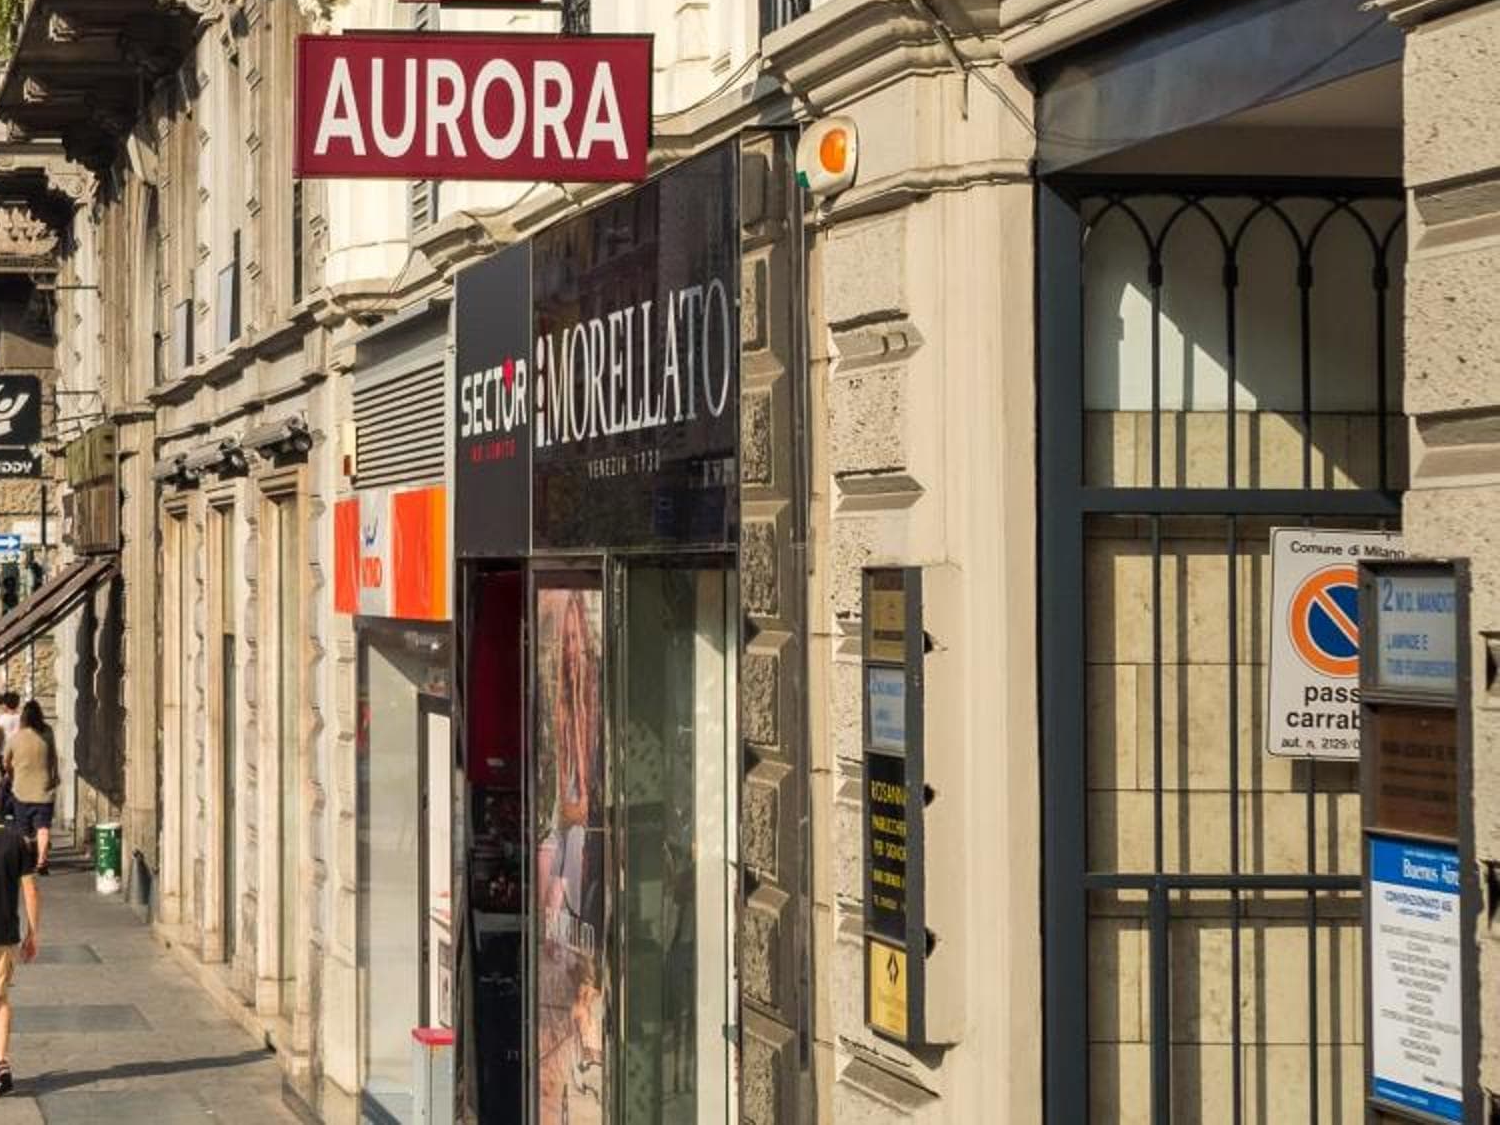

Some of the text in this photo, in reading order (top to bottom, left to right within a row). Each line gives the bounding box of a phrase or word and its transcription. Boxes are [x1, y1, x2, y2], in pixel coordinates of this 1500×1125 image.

[315, 57, 629, 160] AURORA
[461, 357, 527, 437] SECTOR
[547, 278, 730, 445] MORELLATO
[1290, 540, 1405, 560] Comune di Milano
